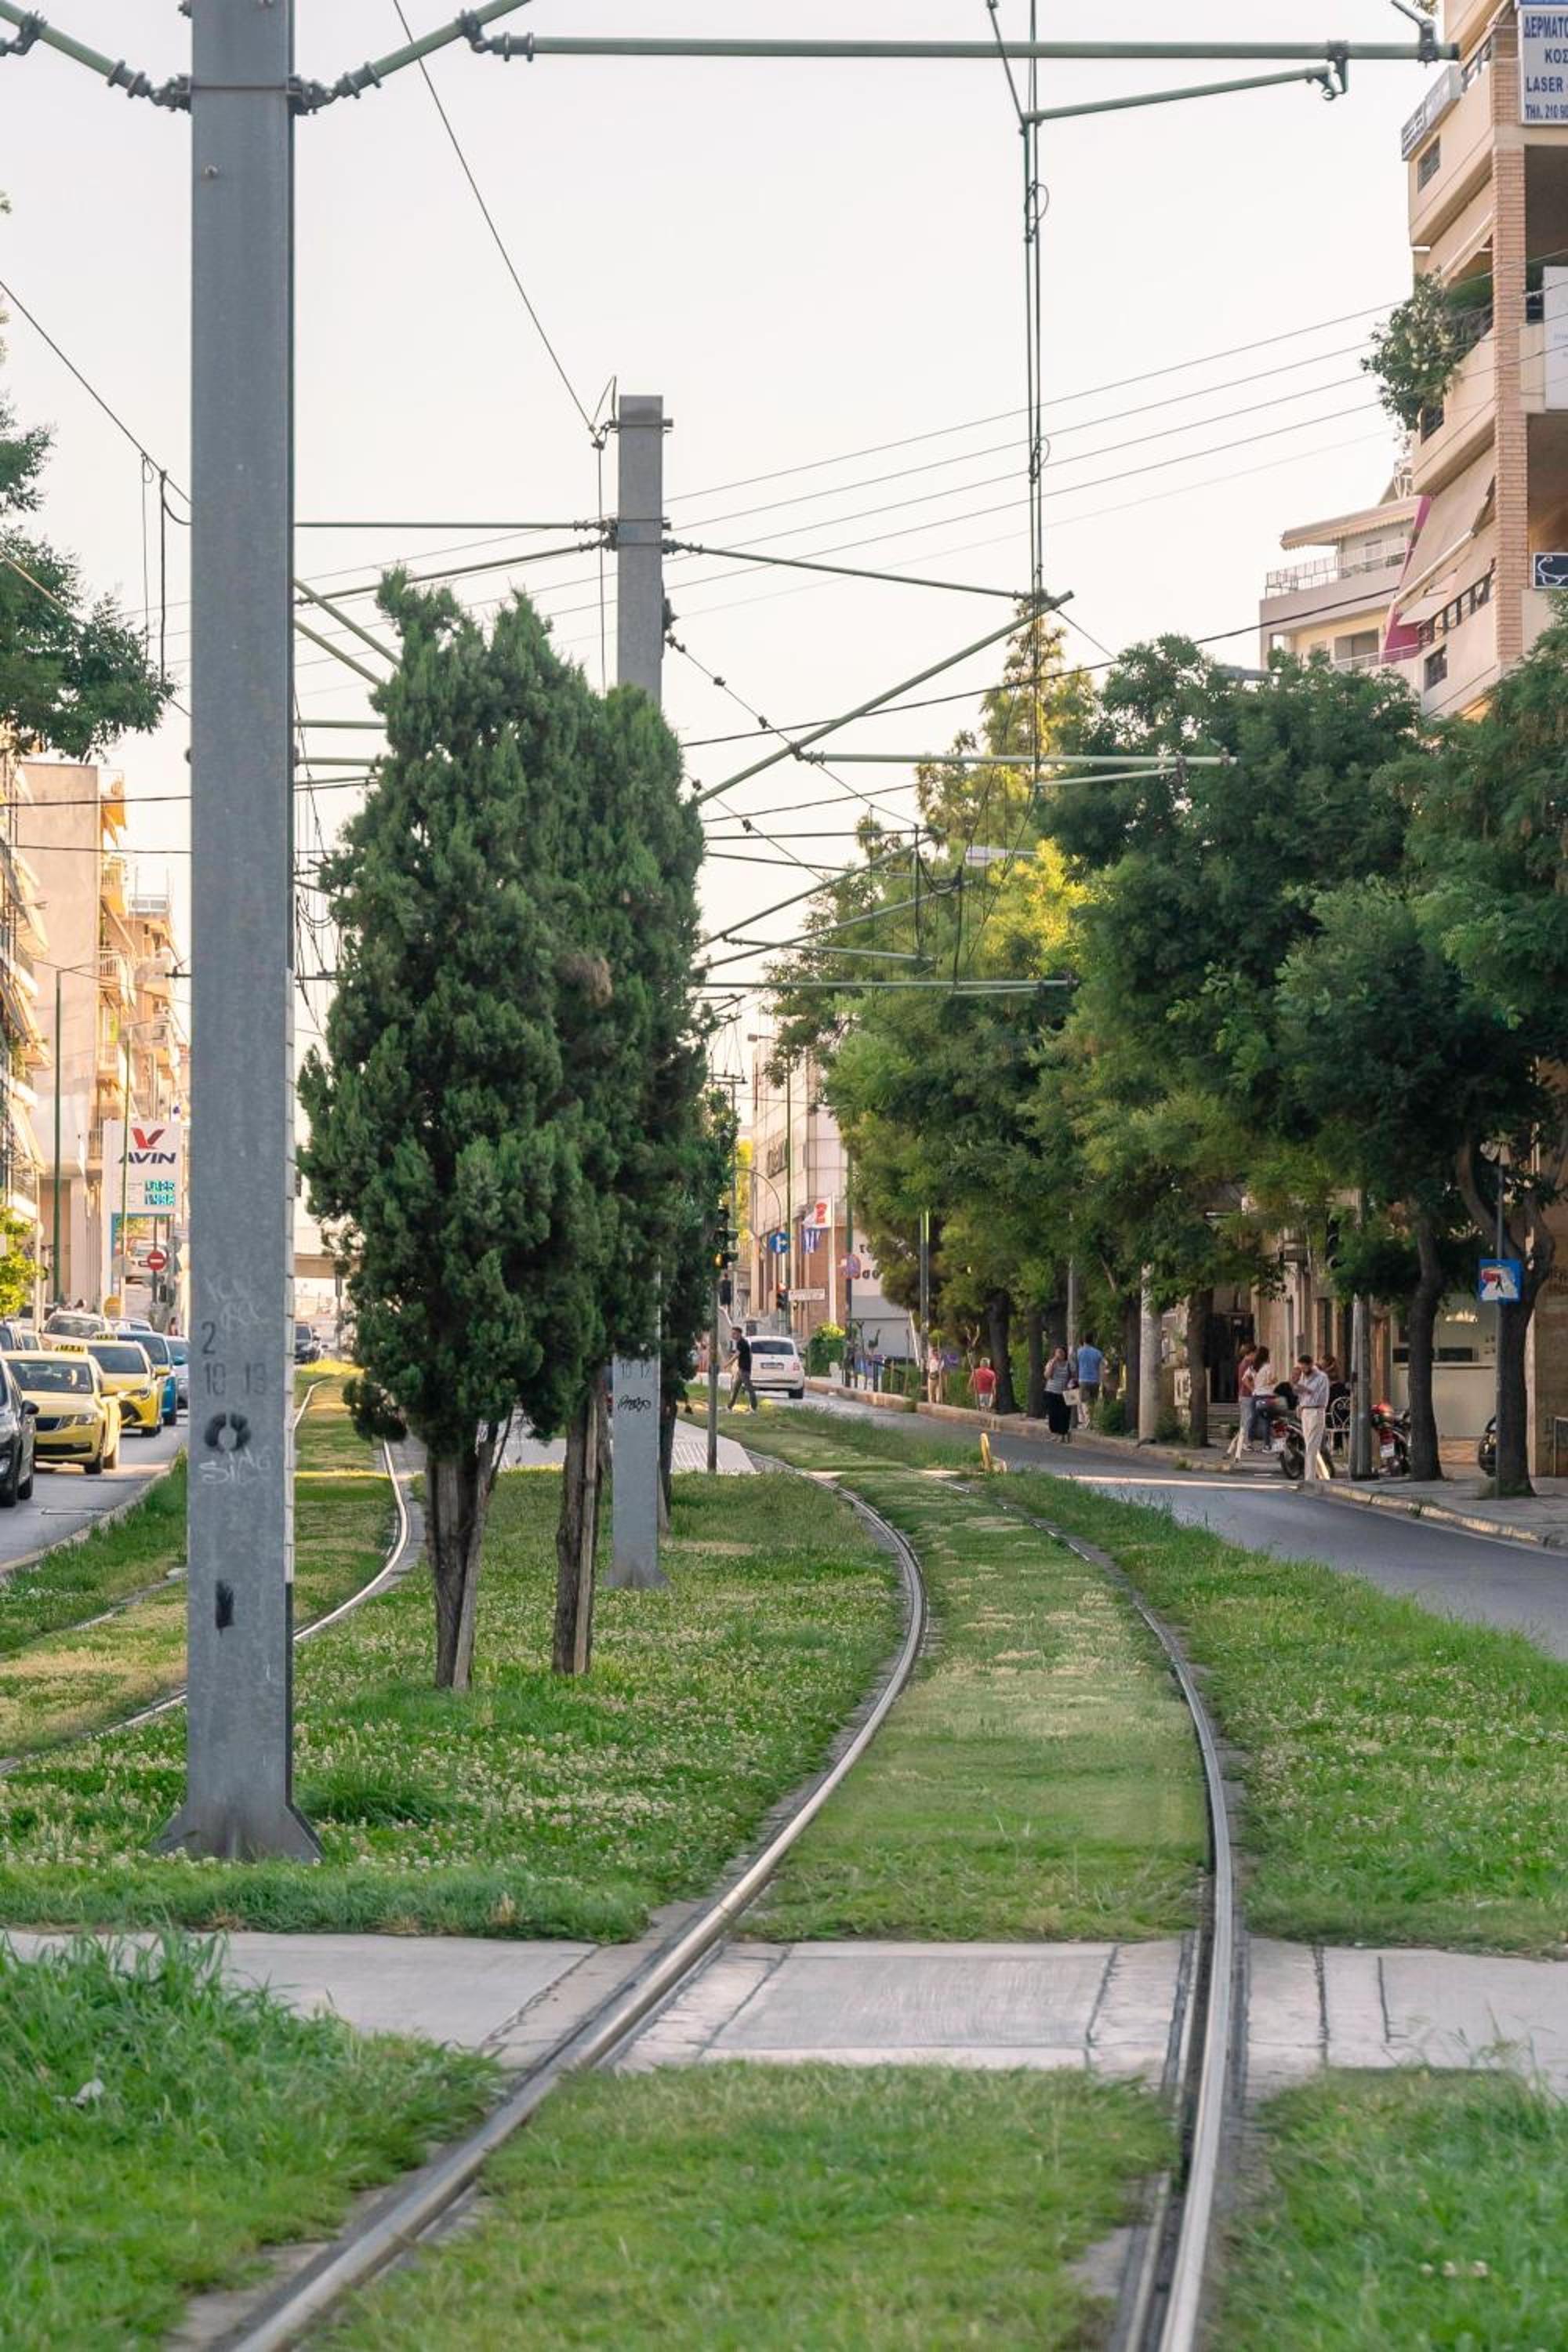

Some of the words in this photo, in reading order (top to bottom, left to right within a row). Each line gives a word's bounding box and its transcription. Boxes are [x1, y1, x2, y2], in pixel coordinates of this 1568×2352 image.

[1526, 77, 1563, 93] LASER
[118, 1152, 176, 1163] AVIN
[201, 1321, 216, 1355] 2
